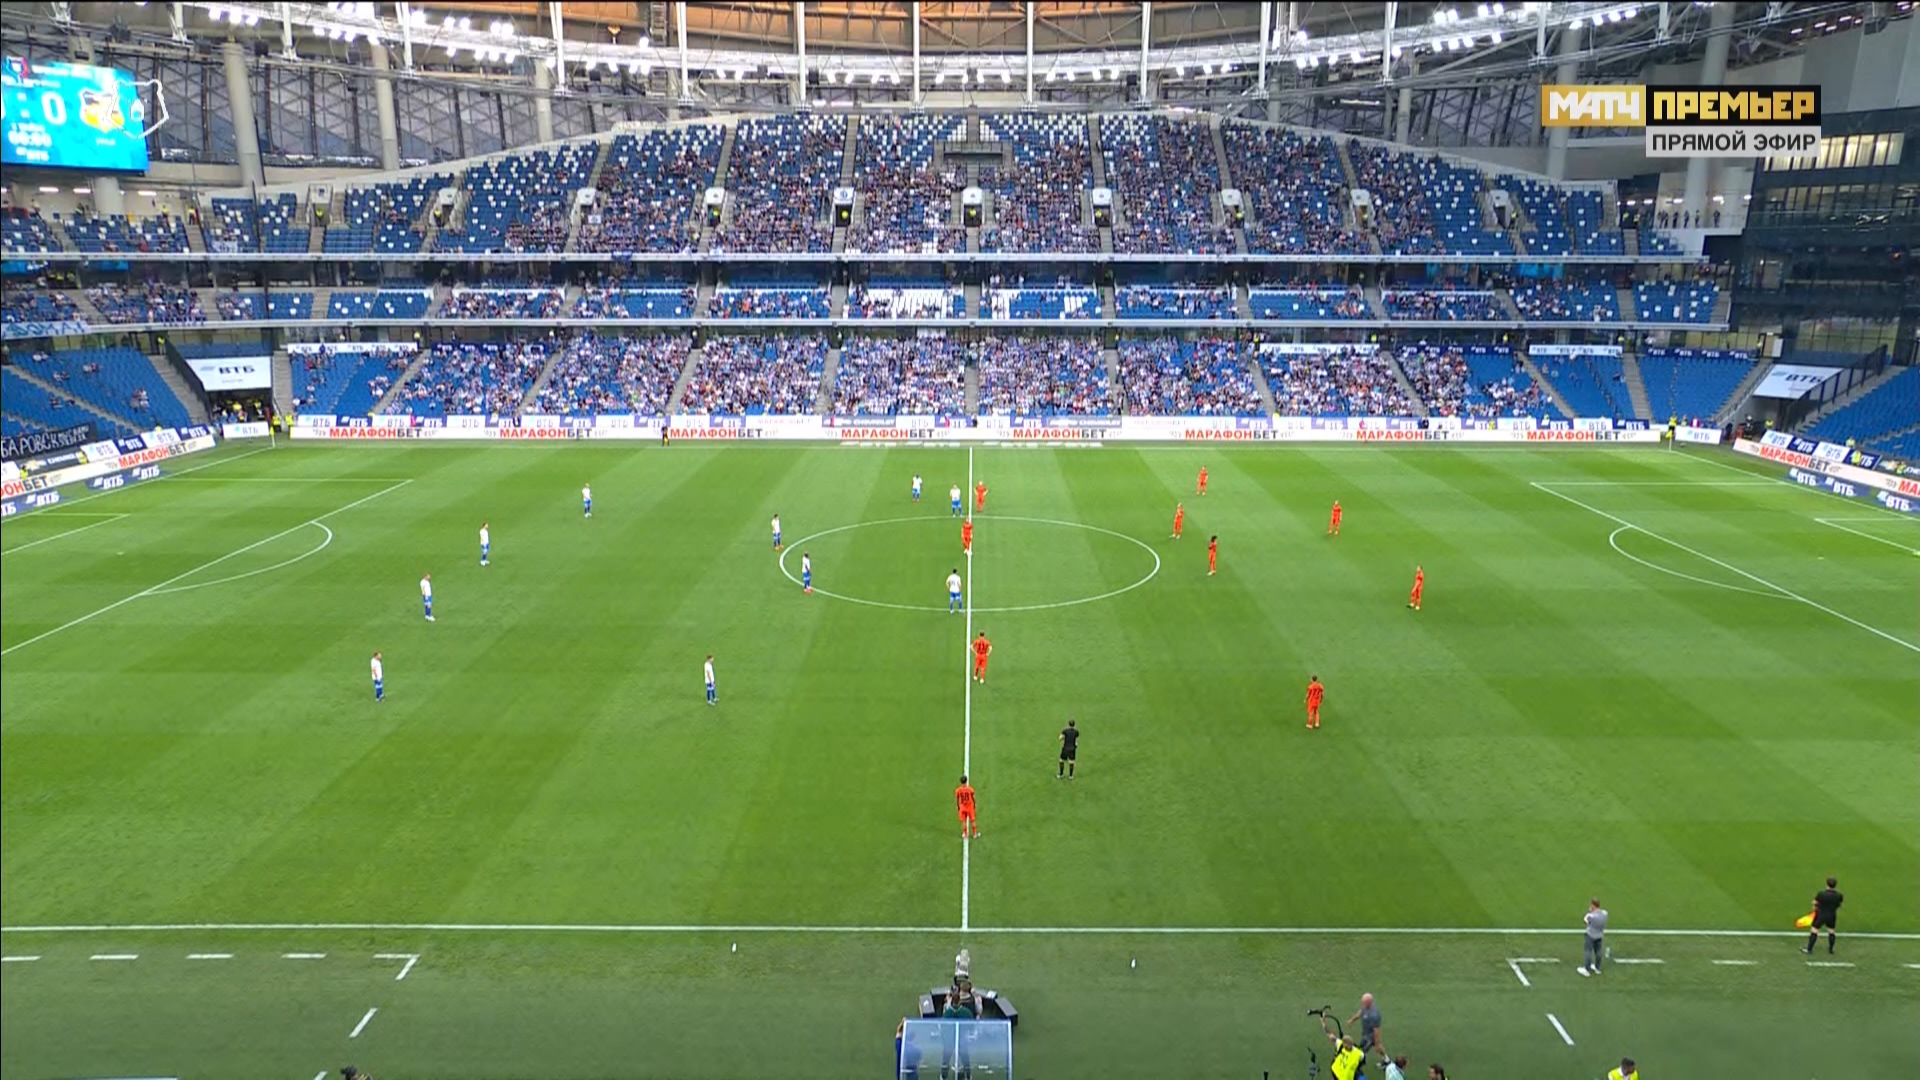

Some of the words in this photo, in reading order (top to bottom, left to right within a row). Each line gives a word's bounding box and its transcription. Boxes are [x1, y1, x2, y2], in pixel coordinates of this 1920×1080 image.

[219, 365, 255, 375] ВТБ
[1786, 373, 1824, 383] ВТБ
[313, 417, 331, 427] ВТБ
[349, 417, 368, 427] ВТБ
[388, 417, 405, 427] ВТБ
[424, 417, 442, 427] ВТБ
[1513, 420, 1530, 430] ВТБ
[1550, 420, 1569, 430] ВТБ
[1588, 420, 1607, 430] ВТБ
[1626, 420, 1645, 430] ВТБ
[189, 426, 207, 438] ВТБ
[243, 426, 258, 435] ВТБ
[330, 428, 422, 438] МАРАФОНБЕТ
[500, 428, 592, 438] МАРАФОНБЕТ
[670, 428, 763, 438] МАРАФОНБЕТ
[842, 429, 935, 439] МАРАФОНБЕТ
[1013, 429, 1107, 439] МАРАФОНБЕТ
[1185, 430, 1279, 440] МАРАФОНБЕТ
[1356, 430, 1449, 440] МАРАФОНБЕТ
[157, 431, 175, 443] ВТБ
[1527, 431, 1621, 441] МАРАФОНБЕТ
[1693, 431, 1710, 441] ВТБ
[1771, 433, 1788, 446] ВТБ
[126, 438, 144, 450] ВТБ
[1797, 440, 1816, 453] ВТБ
[96, 444, 114, 456] ВТБ
[1825, 447, 1843, 459] ВТБ
[118, 443, 188, 468] МАРАФОНБЕТ
[1760, 446, 1832, 472] МАРАФОНБЕТ
[140, 465, 160, 480] ВТБ
[102, 474, 125, 490] ВТБ
[1797, 472, 1817, 486] ВТБ
[1833, 481, 1855, 497] ВТБ
[1899, 479, 1920, 496] МА
[36, 491, 60, 507] ВТБ
[1886, 495, 1911, 511] ВТБ
